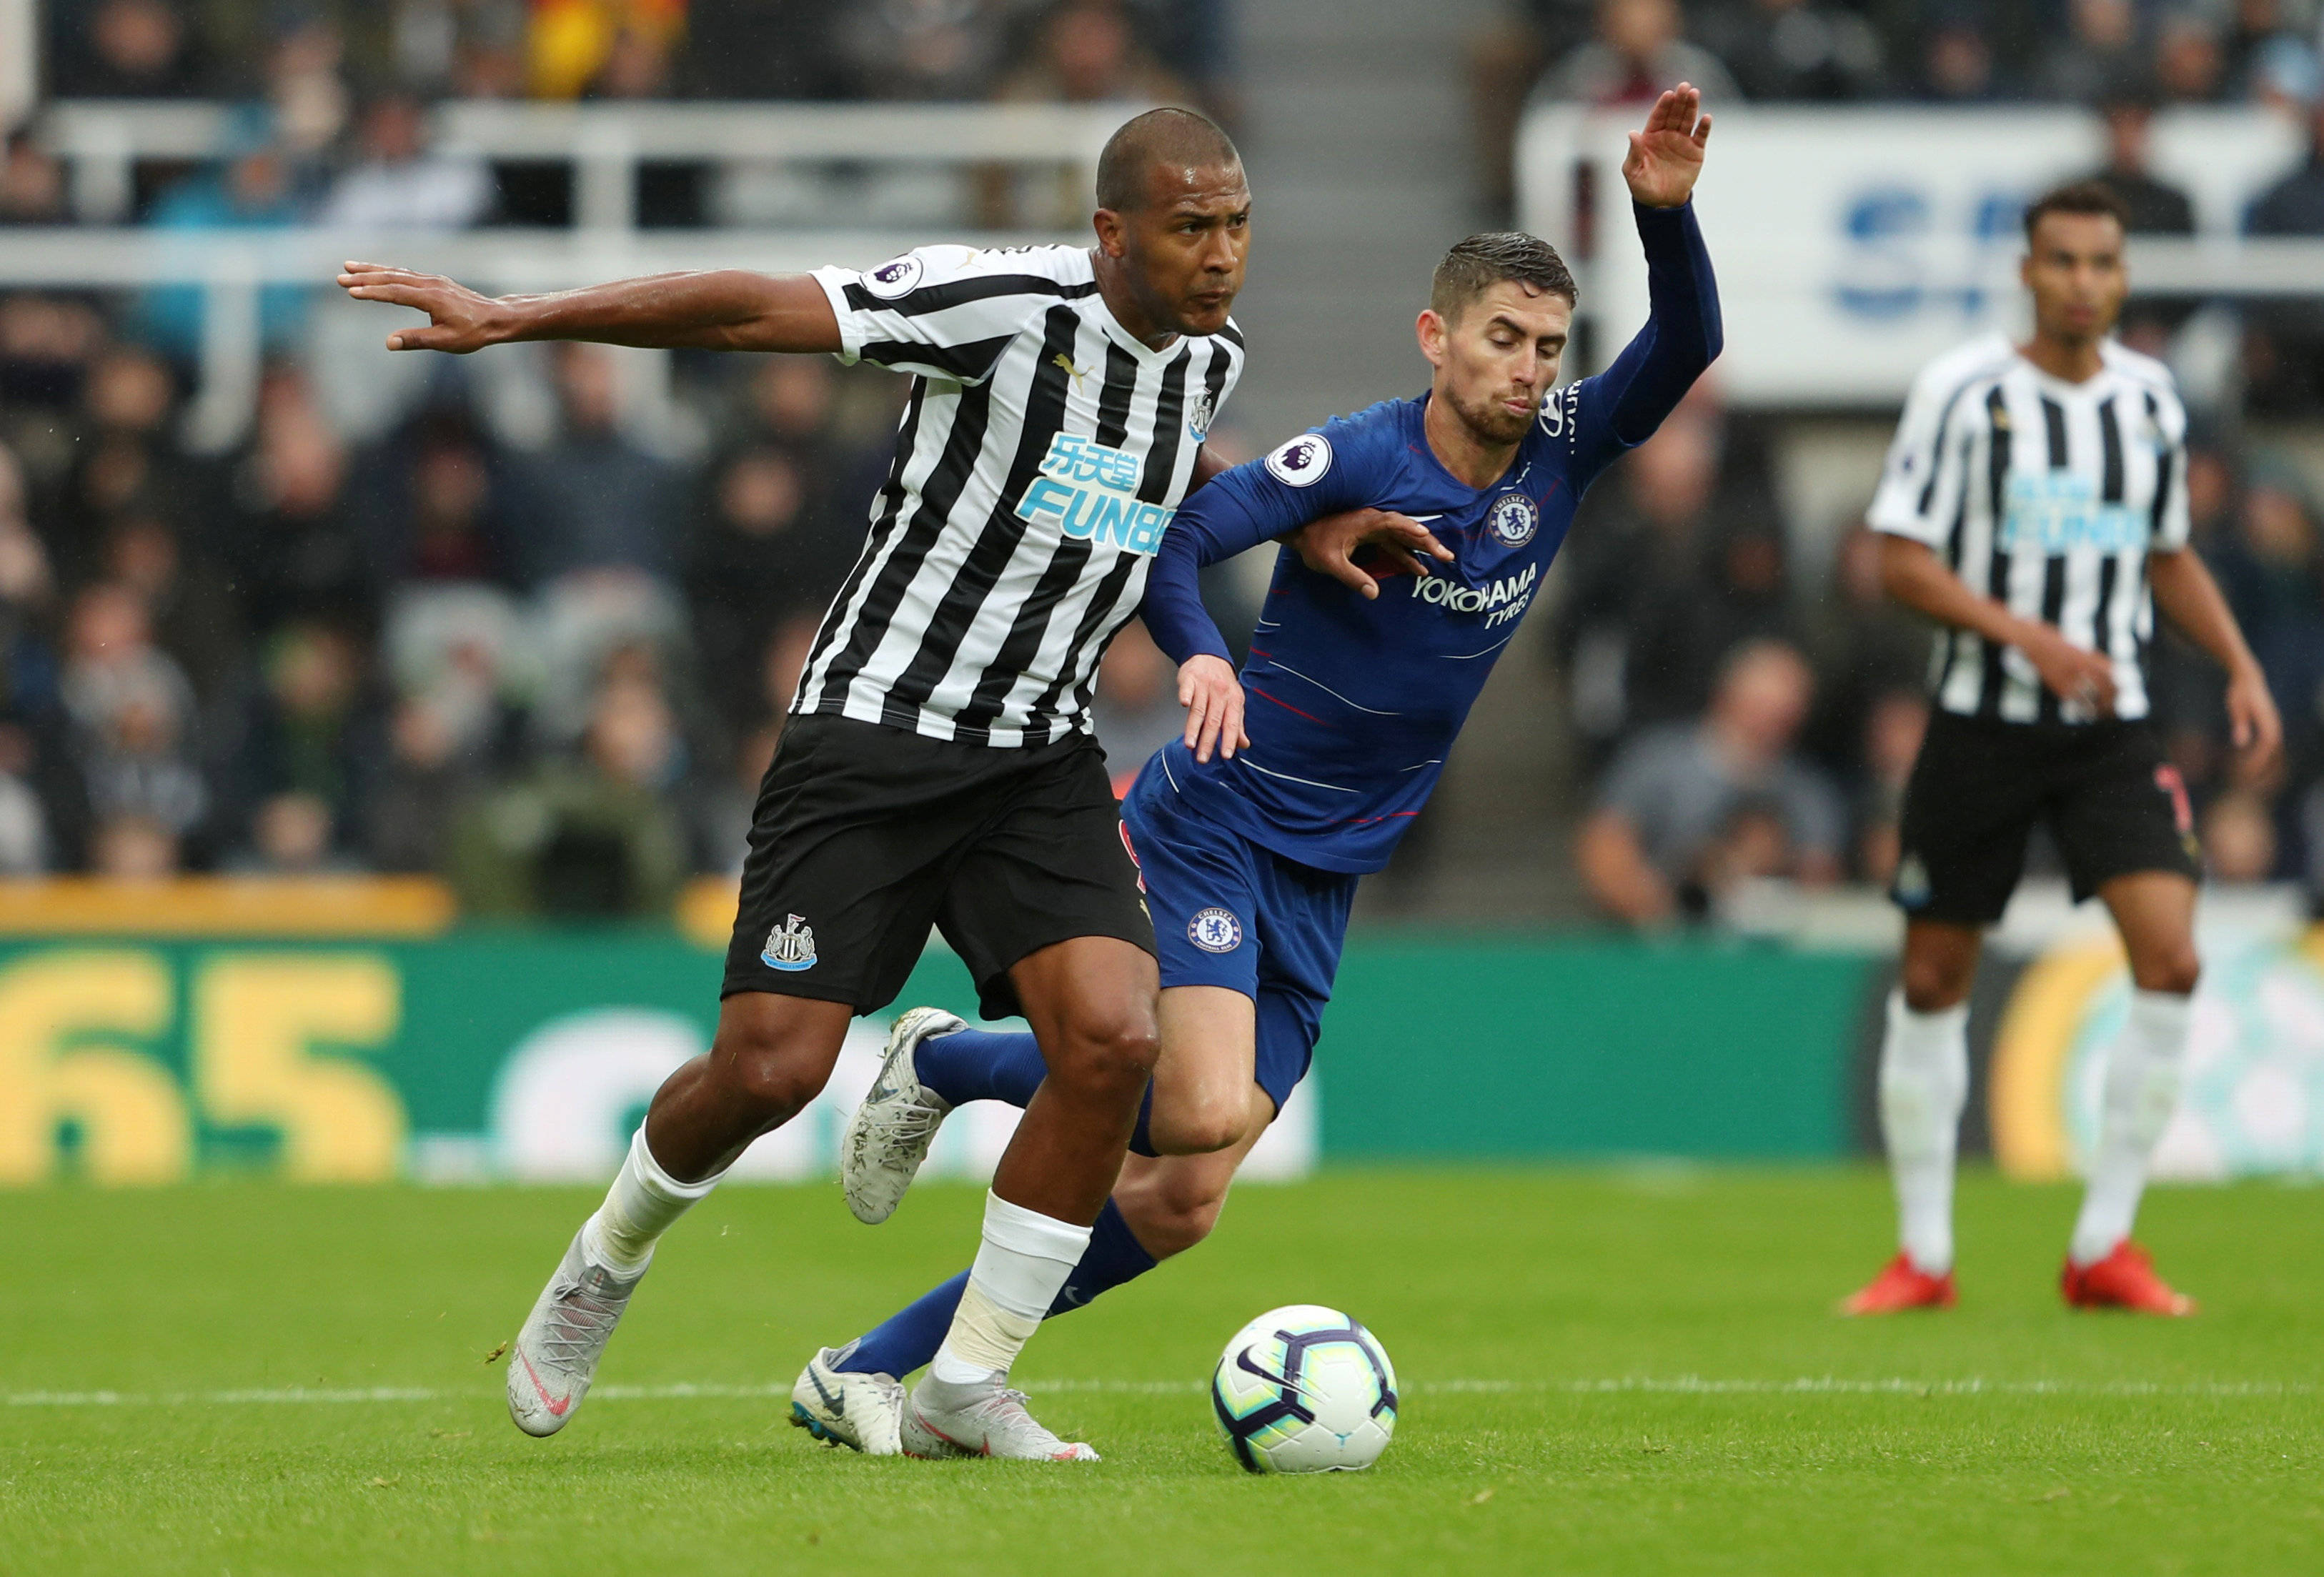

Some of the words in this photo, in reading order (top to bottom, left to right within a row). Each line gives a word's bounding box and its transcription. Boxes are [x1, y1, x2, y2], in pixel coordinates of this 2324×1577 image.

[1494, 496, 1524, 513] CHELSEA
[1411, 562, 1536, 612] YOKOHAMA
[1198, 910, 1232, 922] CHELSEA
